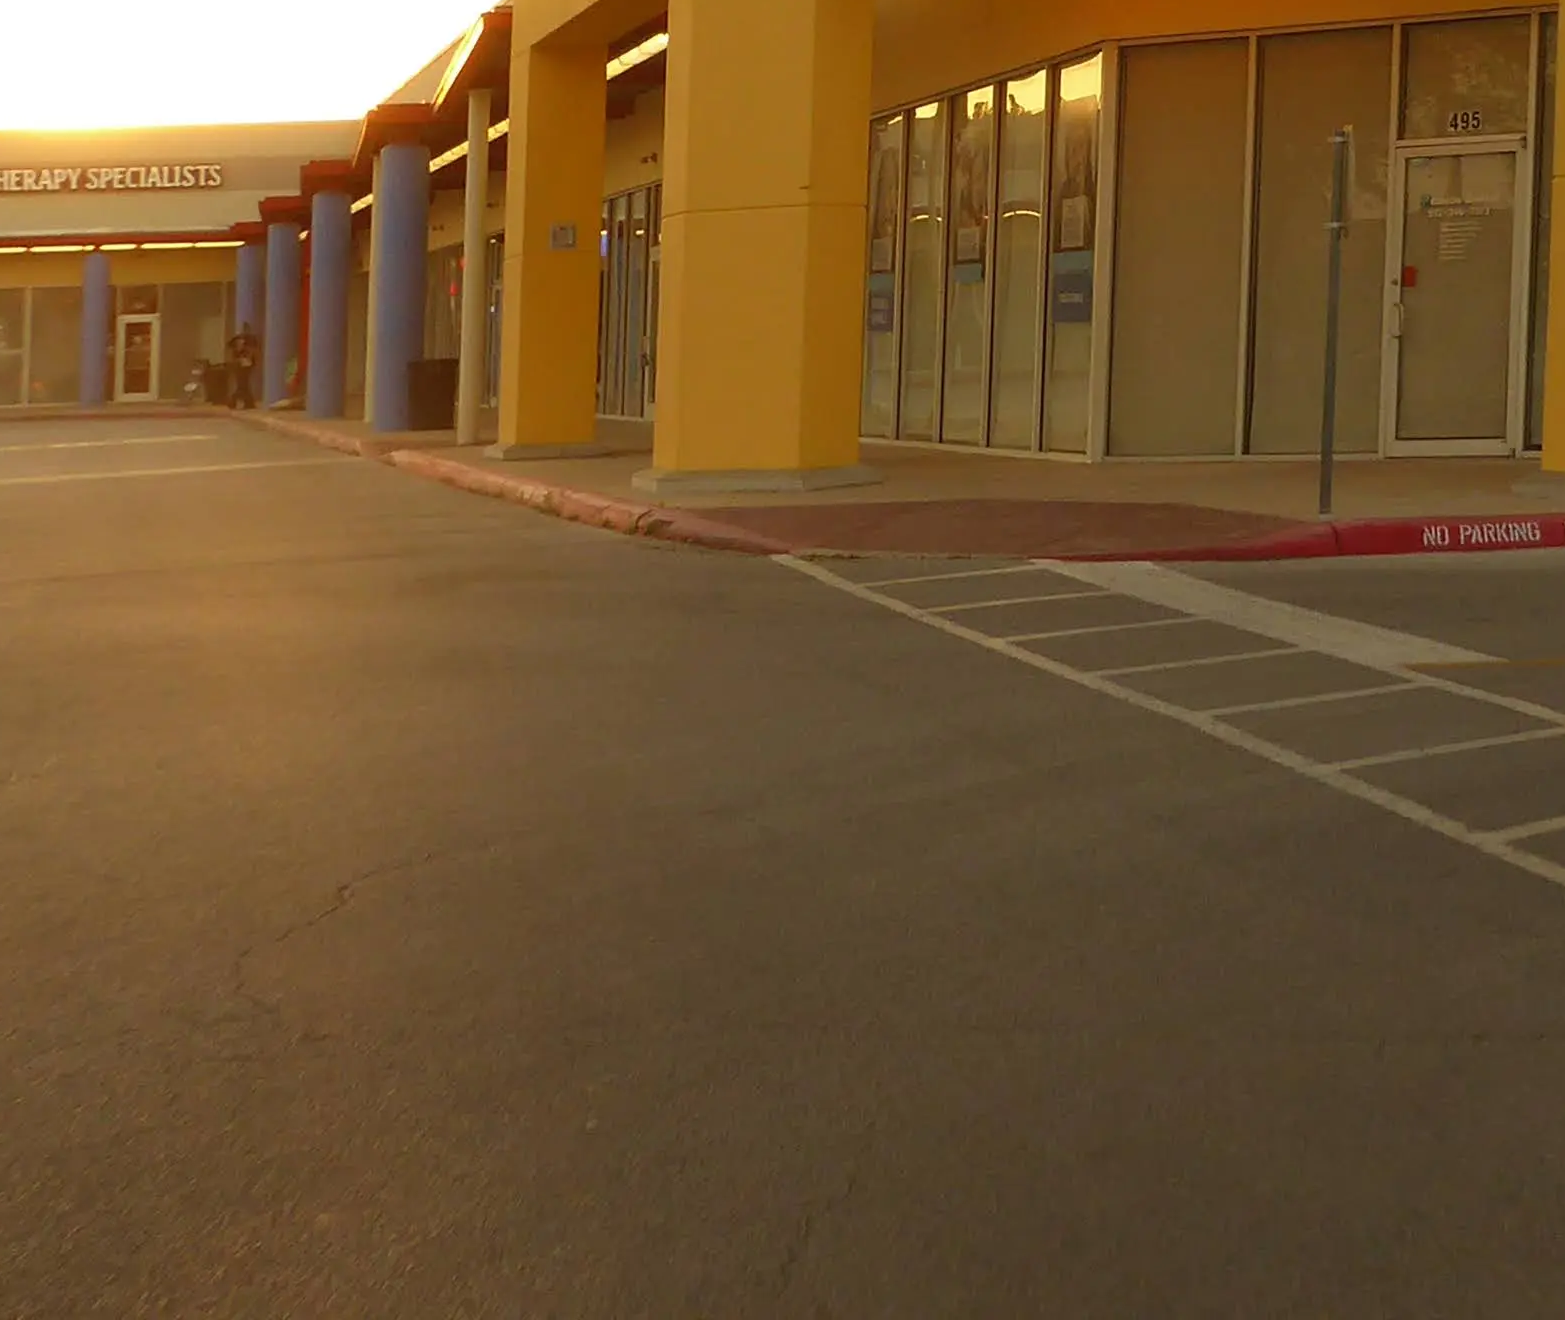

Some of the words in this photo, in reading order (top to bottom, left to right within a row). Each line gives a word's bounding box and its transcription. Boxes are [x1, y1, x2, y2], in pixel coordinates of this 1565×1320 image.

[1449, 111, 1480, 130] 495
[84, 164, 222, 190] SPECIALISTS
[1422, 525, 1450, 546] NO
[1459, 521, 1542, 545] PARKING
